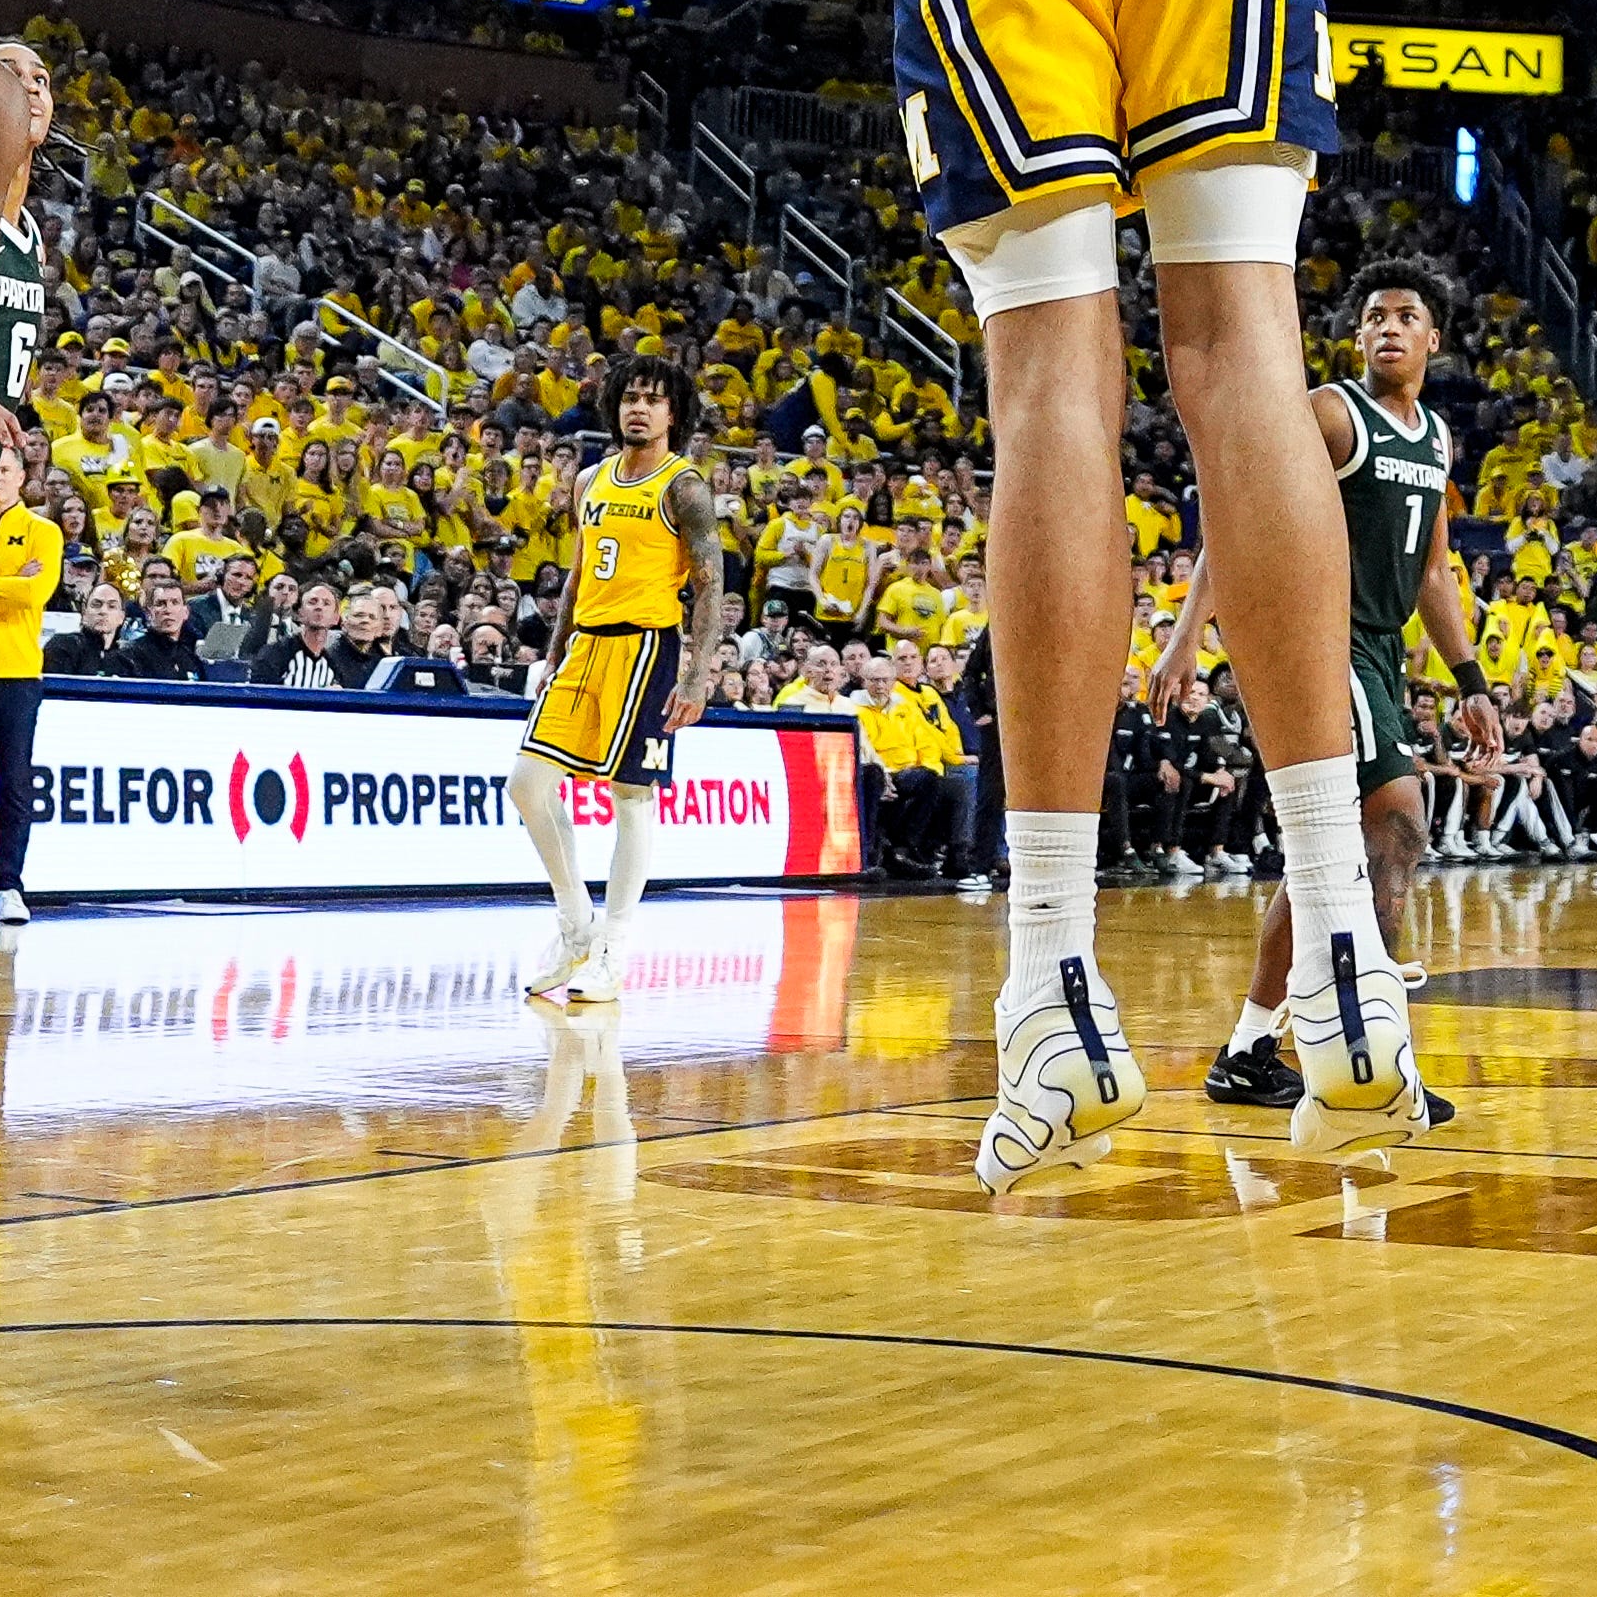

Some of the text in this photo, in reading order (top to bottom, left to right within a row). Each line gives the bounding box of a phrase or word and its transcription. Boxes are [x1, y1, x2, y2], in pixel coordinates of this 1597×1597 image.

[1348, 38, 1543, 80] SSAN
[6, 321, 37, 399] 6
[7, 534, 25, 547] M
[1404, 494, 1424, 554] 1
[593, 535, 621, 581] 3
[641, 736, 669, 772] M
[29, 765, 771, 827] BELFOR PROPERT ESRATION
